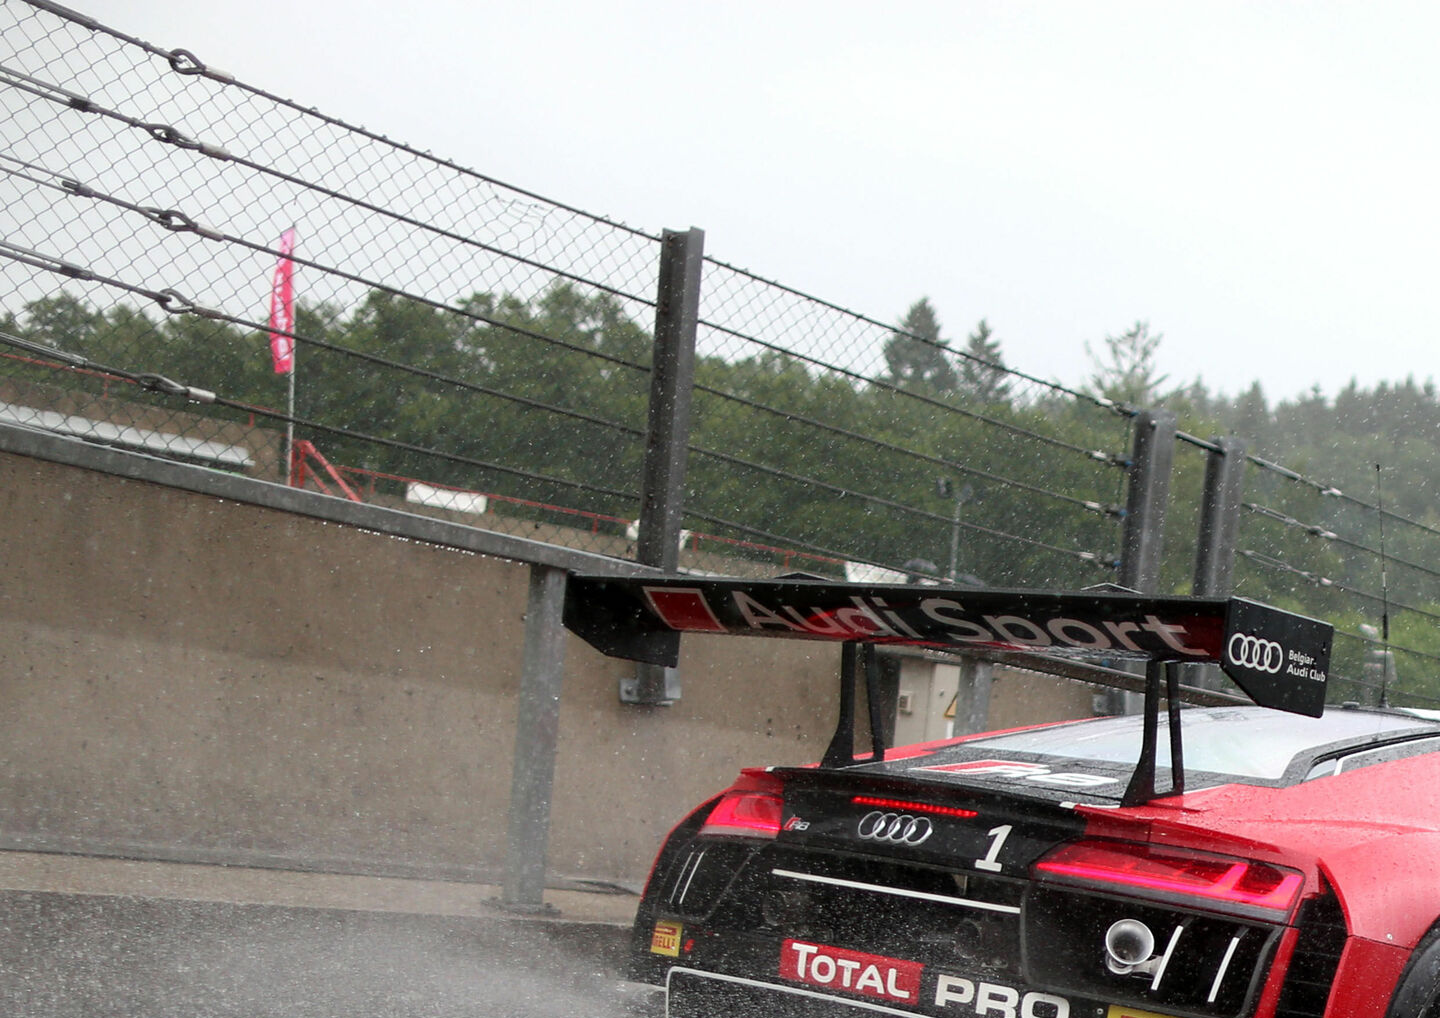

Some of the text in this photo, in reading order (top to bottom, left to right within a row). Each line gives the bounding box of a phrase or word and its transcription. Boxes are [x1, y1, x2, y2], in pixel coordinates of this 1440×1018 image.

[731, 590, 1211, 656] Audi Sport
[1286, 664, 1326, 682] Audi Club
[975, 824, 1012, 872] 1
[791, 942, 910, 999] TOTAL
